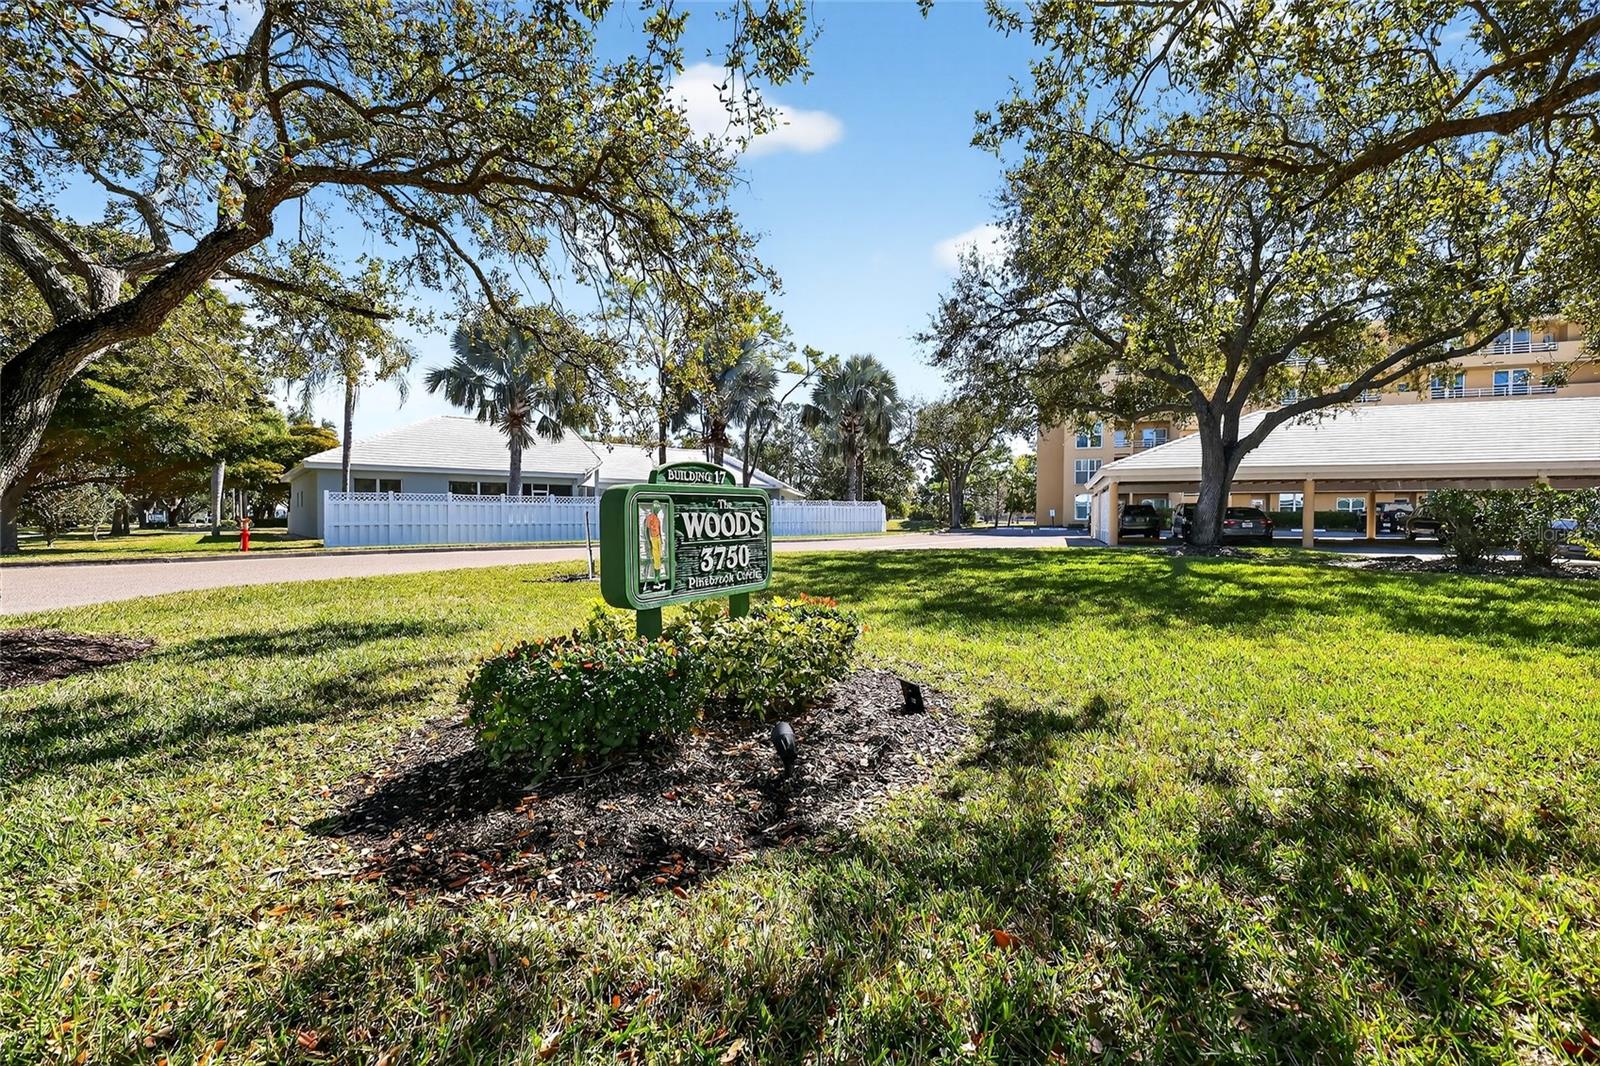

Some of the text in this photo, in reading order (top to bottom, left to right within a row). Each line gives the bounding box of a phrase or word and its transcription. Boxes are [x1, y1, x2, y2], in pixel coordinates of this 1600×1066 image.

[668, 469, 726, 484] BUILDING 17
[717, 499, 732, 509] The
[682, 510, 764, 538] WOODS
[701, 545, 750, 572] 3750
[688, 569, 763, 589] Pinebrook Circle
